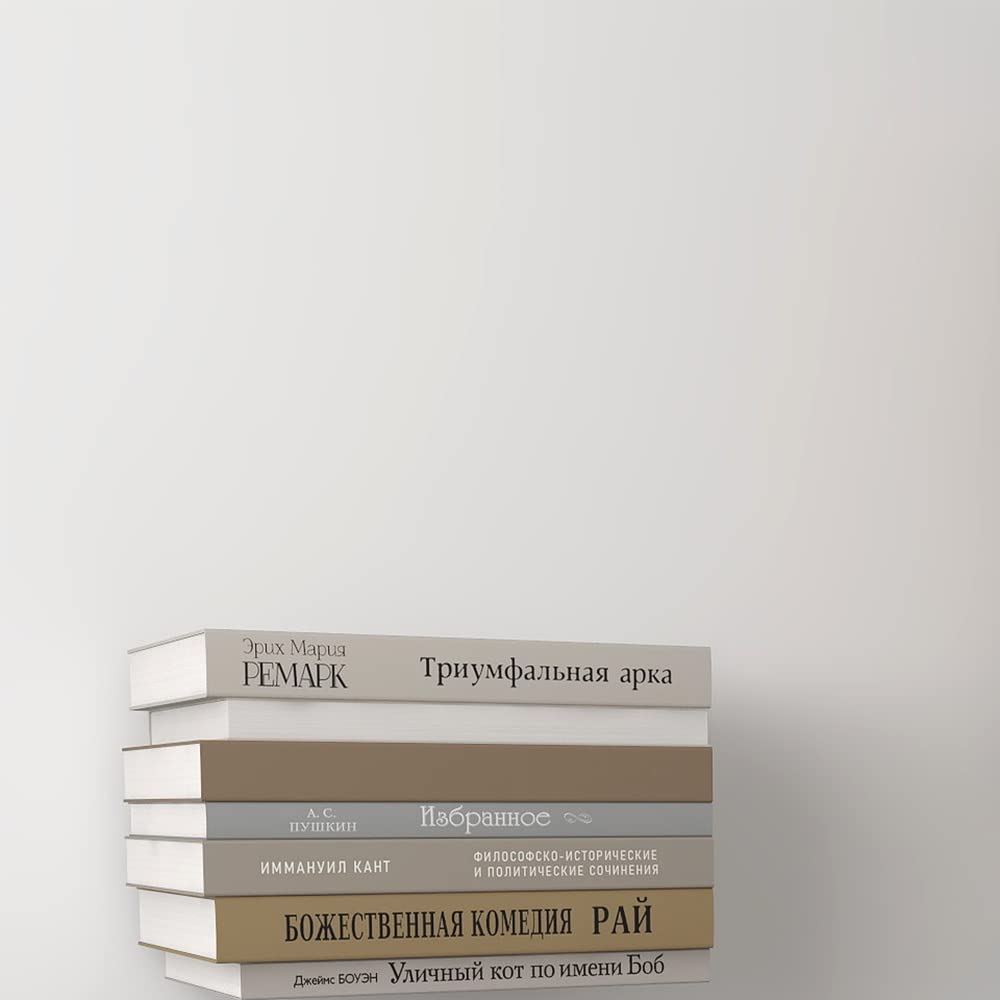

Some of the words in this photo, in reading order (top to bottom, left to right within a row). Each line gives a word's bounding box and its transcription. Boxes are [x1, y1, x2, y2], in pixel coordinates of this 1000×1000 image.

[243, 637, 285, 659] Эрих
[290, 639, 347, 661] Мария
[242, 661, 349, 689] РЕМАРК
[420, 656, 609, 688] Триумфальная
[620, 664, 674, 690] арка
[307, 808, 320, 819] А.
[323, 808, 336, 819] С.
[419, 804, 552, 835] Избранное
[289, 821, 358, 833] ПУШКИН
[260, 860, 347, 875] ИММАНУИЛ
[353, 860, 391, 873] КАНТ
[473, 849, 658, 863] ФИЛОСОФСКО-ИСТОРИЧЕСКИЕ
[474, 866, 482, 878] И
[487, 865, 585, 878] ПОЛИТИЧЕСКИЕ
[589, 864, 660, 877] СОЧИНЕНИЯ
[284, 910, 465, 942] БОЖЕСТВЕННАЯ
[471, 908, 573, 940] КОМЕДИЯ
[592, 896, 653, 936] РАЙ
[293, 974, 336, 989] Джеймс
[338, 972, 378, 985] БОУЭН
[388, 960, 484, 985] Уличный
[490, 963, 525, 980] кот
[530, 964, 555, 979] по
[559, 961, 624, 978] имени
[626, 953, 665, 975] Боб
